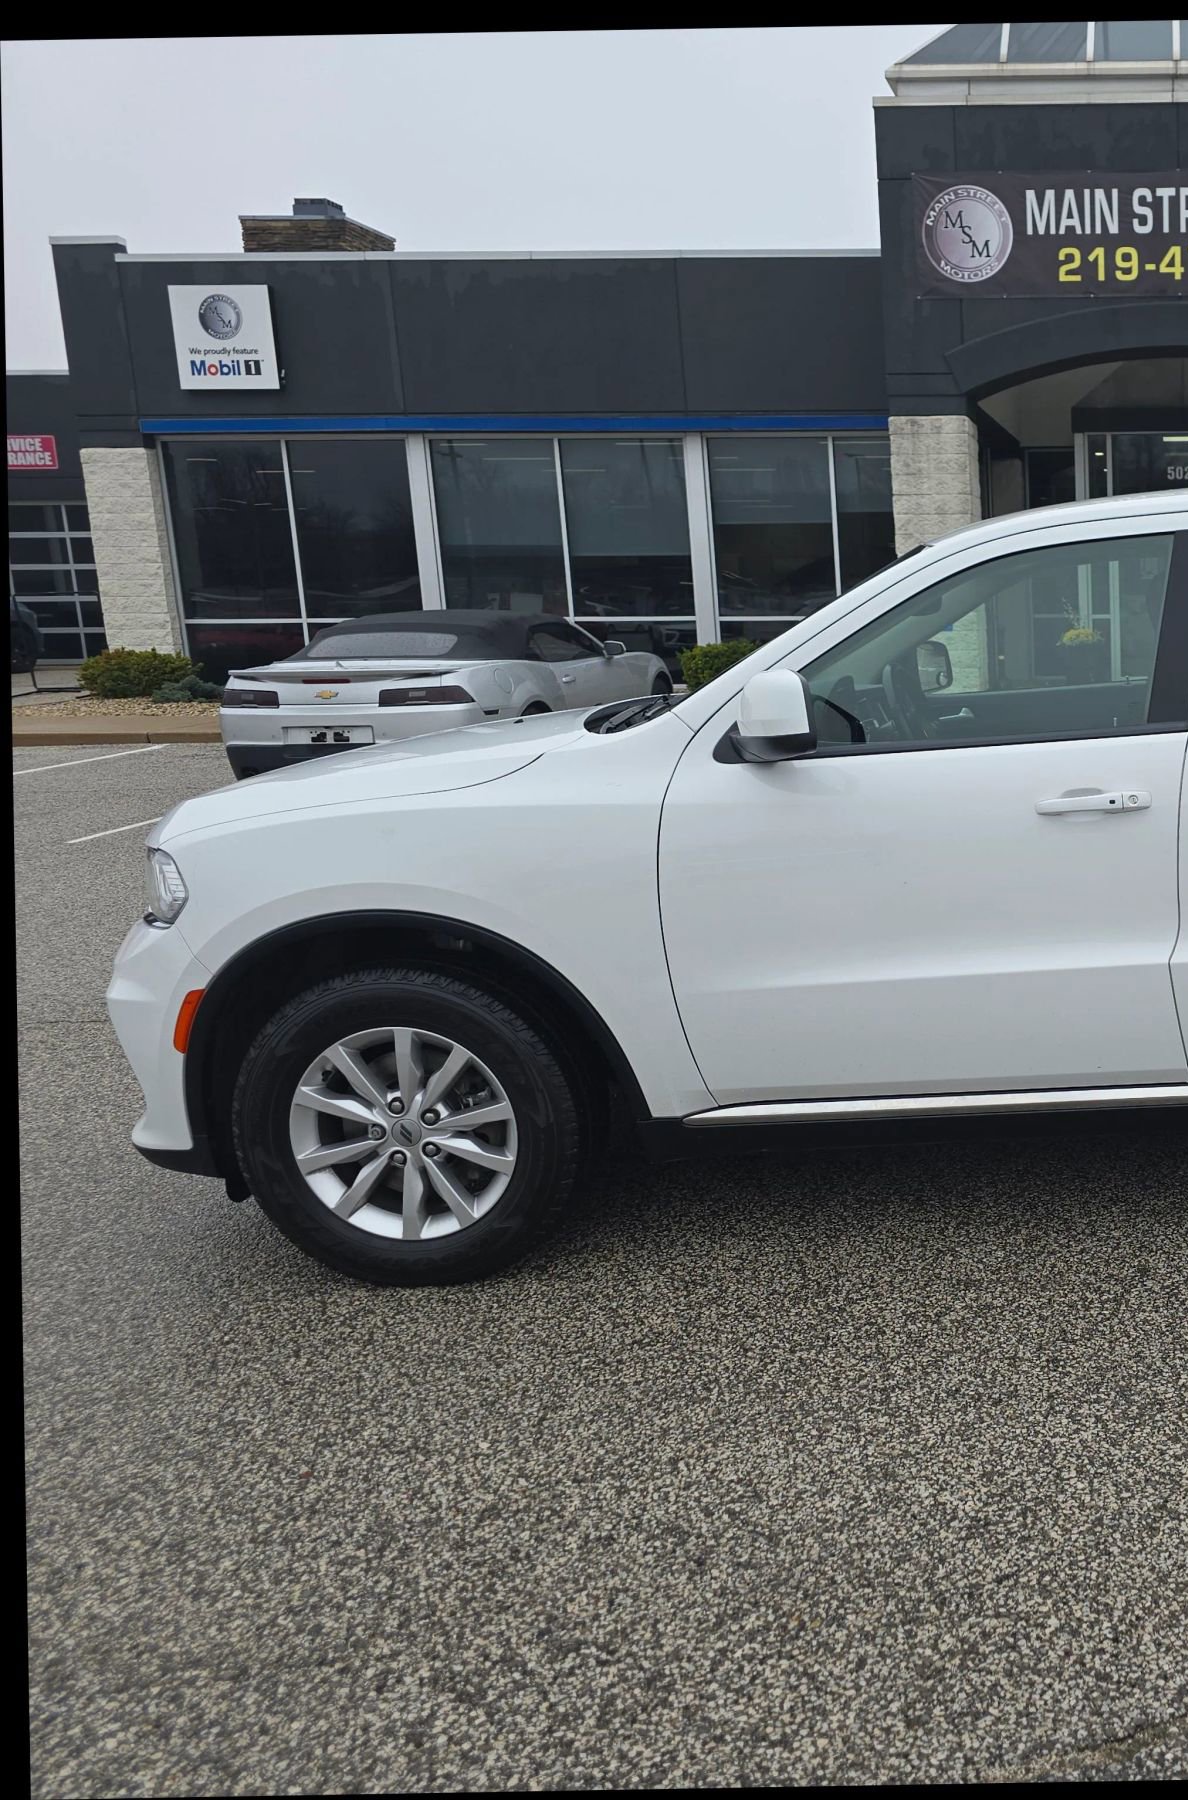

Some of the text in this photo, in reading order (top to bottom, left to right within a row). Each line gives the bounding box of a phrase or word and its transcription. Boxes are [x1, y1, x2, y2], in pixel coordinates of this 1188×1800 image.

[926, 191, 955, 226] MAIN
[1025, 188, 1119, 235] MAIN
[940, 260, 1000, 280] MOTORS
[188, 347, 259, 357] We proudly feature
[190, 360, 241, 376] Mobil
